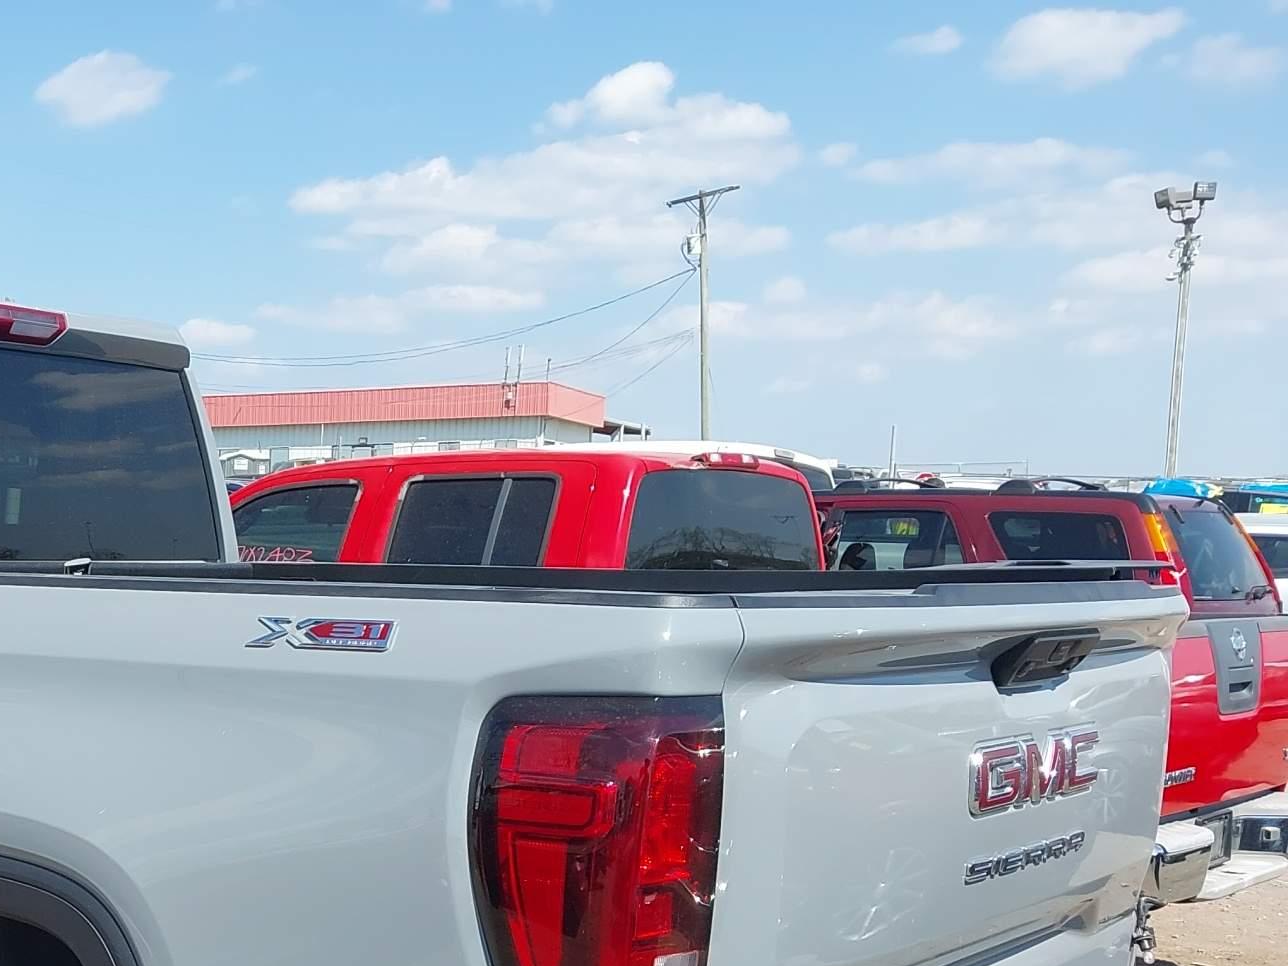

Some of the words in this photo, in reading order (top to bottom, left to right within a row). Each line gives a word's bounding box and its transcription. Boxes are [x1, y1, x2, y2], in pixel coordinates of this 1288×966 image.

[244, 616, 399, 652] X31
[968, 721, 1100, 820] GMC
[963, 831, 1086, 887] SIERRA
